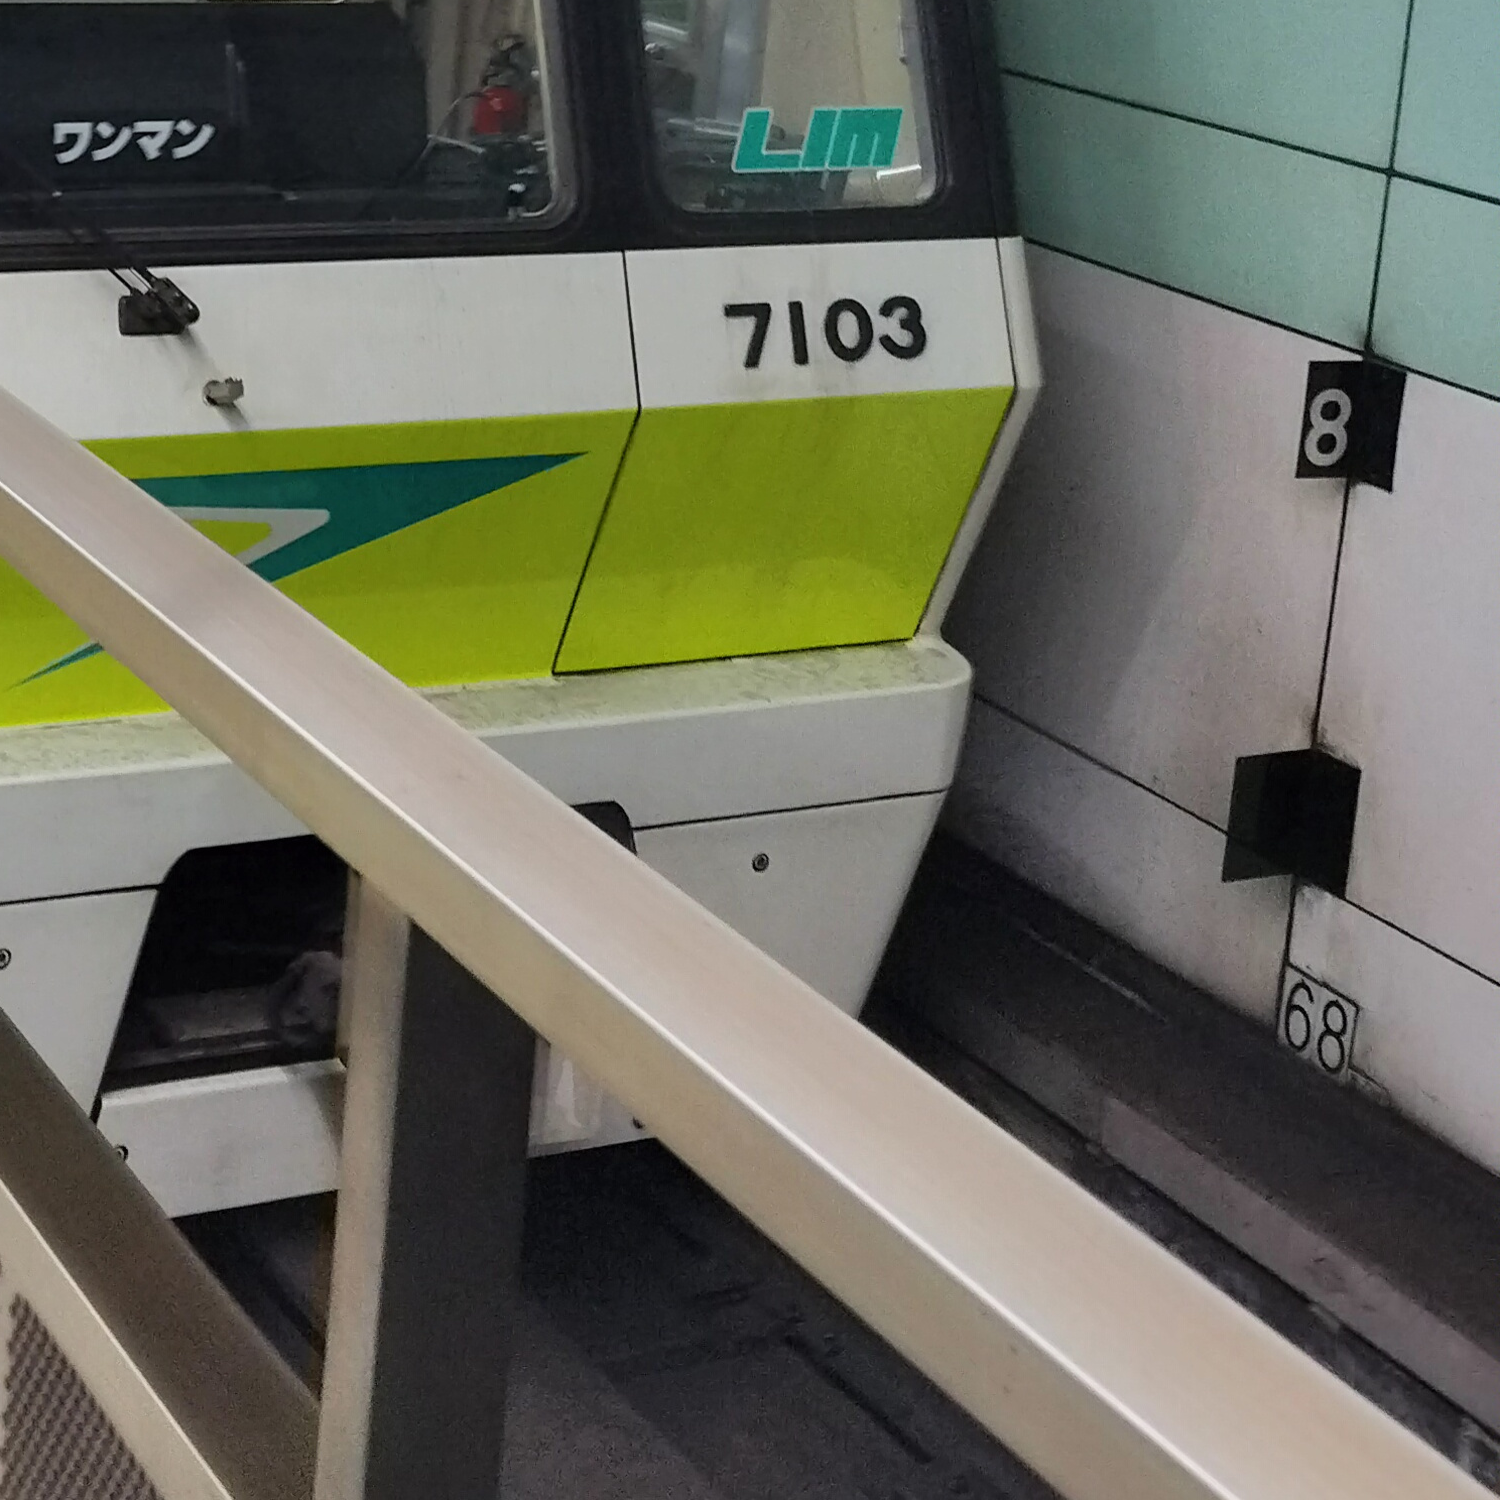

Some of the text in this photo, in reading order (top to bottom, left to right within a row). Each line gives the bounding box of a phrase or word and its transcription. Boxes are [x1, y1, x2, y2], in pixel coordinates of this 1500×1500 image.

[52, 118, 216, 165] ワンマン
[723, 295, 928, 370] 7103
[1303, 387, 1352, 467] 8
[1285, 980, 1348, 1075] 68
